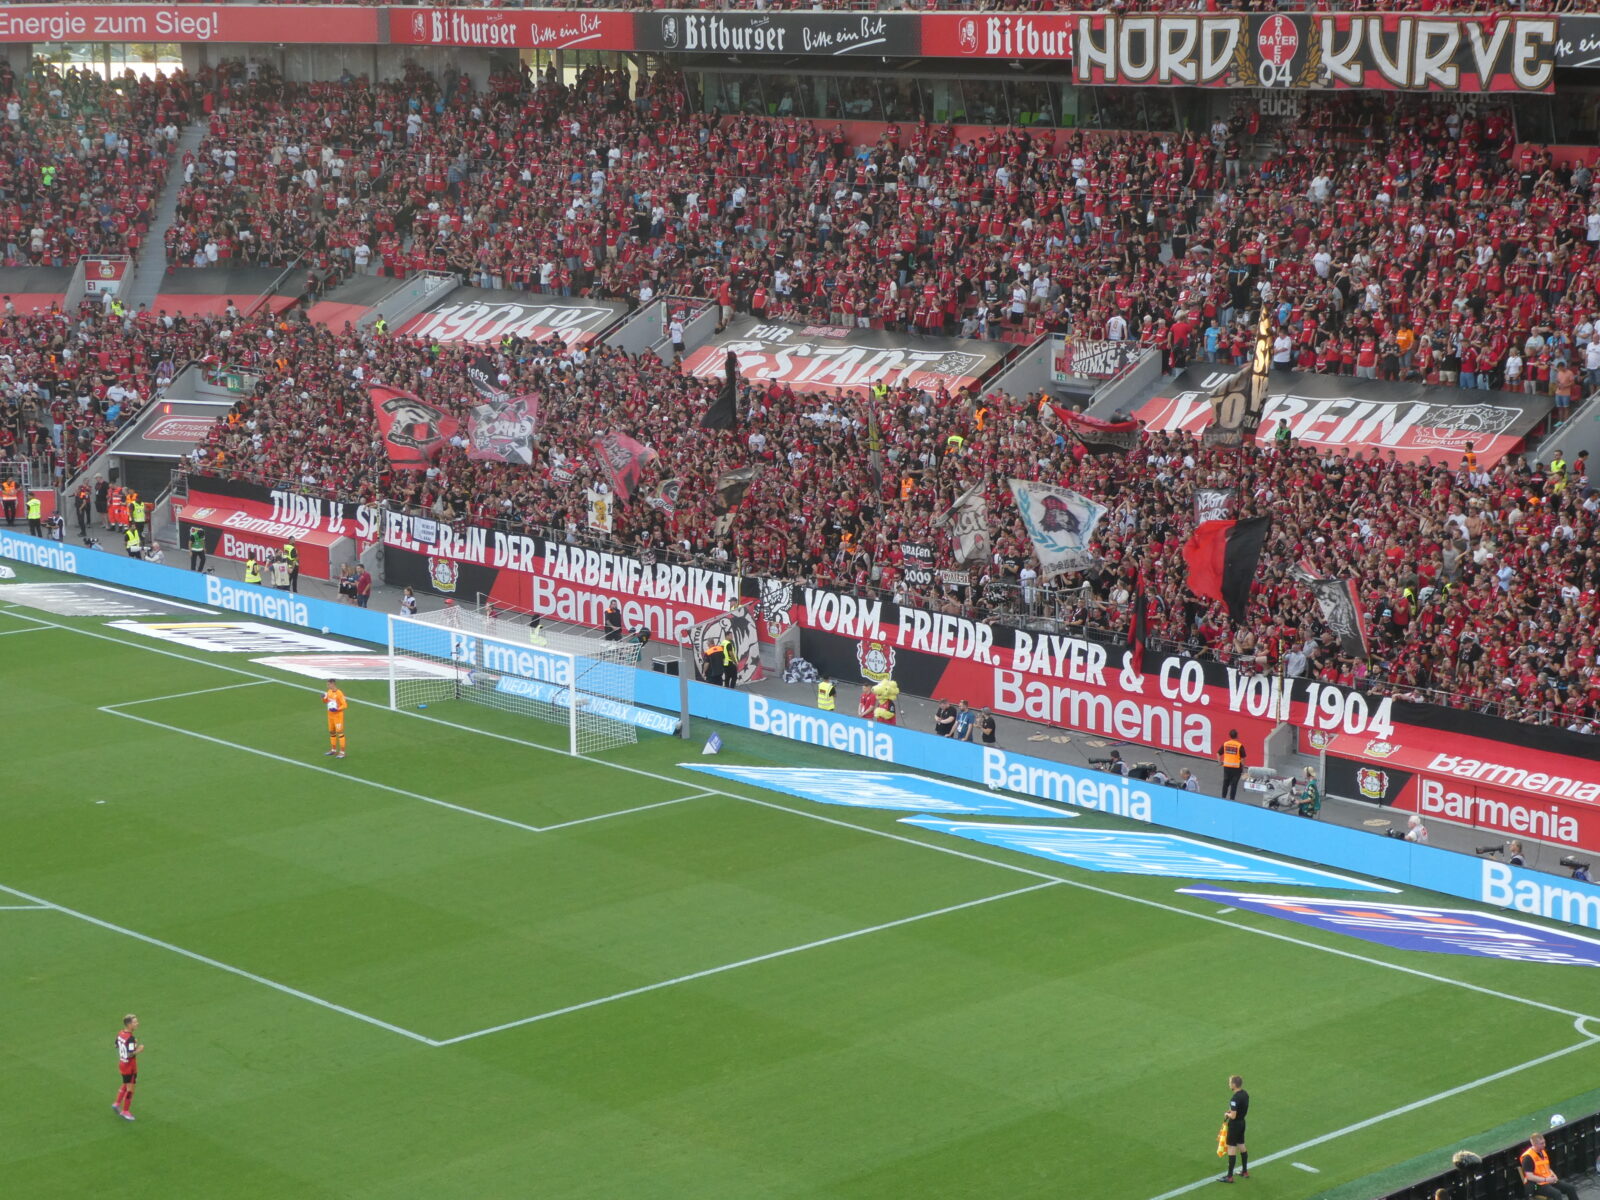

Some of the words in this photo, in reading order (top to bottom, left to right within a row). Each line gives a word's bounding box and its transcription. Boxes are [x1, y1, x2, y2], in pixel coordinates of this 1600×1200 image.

[0, 13, 86, 38] Energie
[94, 17, 148, 34] zum
[155, 12, 219, 38] Sieg!
[431, 11, 517, 45] Bitburger
[531, 24, 557, 44] Bitte
[559, 27, 579, 41] ein
[685, 15, 786, 51] Bitburger
[803, 27, 833, 51] Bitte
[836, 31, 859, 46] ein
[1259, 35, 1297, 46] BAYER
[1078, 18, 1241, 81] NORD
[1321, 19, 1556, 90] KURVE
[1259, 59, 1293, 88] 04
[1260, 99, 1297, 116] EUCH
[743, 324, 795, 343] FÜR
[756, 343, 944, 387] STADT
[1164, 393, 1432, 447] VREIN
[223, 511, 311, 540] Barmenia
[904, 568, 932, 584] 2009
[206, 575, 309, 627] Barmenia
[270, 490, 322, 529] TURN
[328, 501, 345, 534] U.
[494, 532, 535, 573] DER
[543, 541, 741, 612] FARBENFABRIKEN
[804, 588, 887, 641] VORM.
[896, 606, 1001, 666] FRIEDR.
[1012, 629, 1107, 686] BAYER
[1119, 651, 1145, 694] &
[1160, 656, 1210, 706] CO.
[1226, 667, 1295, 721] VON
[1303, 682, 1395, 740] 1904
[634, 711, 677, 732] NIEDAX
[748, 694, 894, 762] Barmenia
[993, 668, 1212, 755] Barmenia
[983, 746, 1152, 823] Barmenia
[1427, 753, 1600, 802] Barmenia
[1422, 779, 1579, 843] Barmenia
